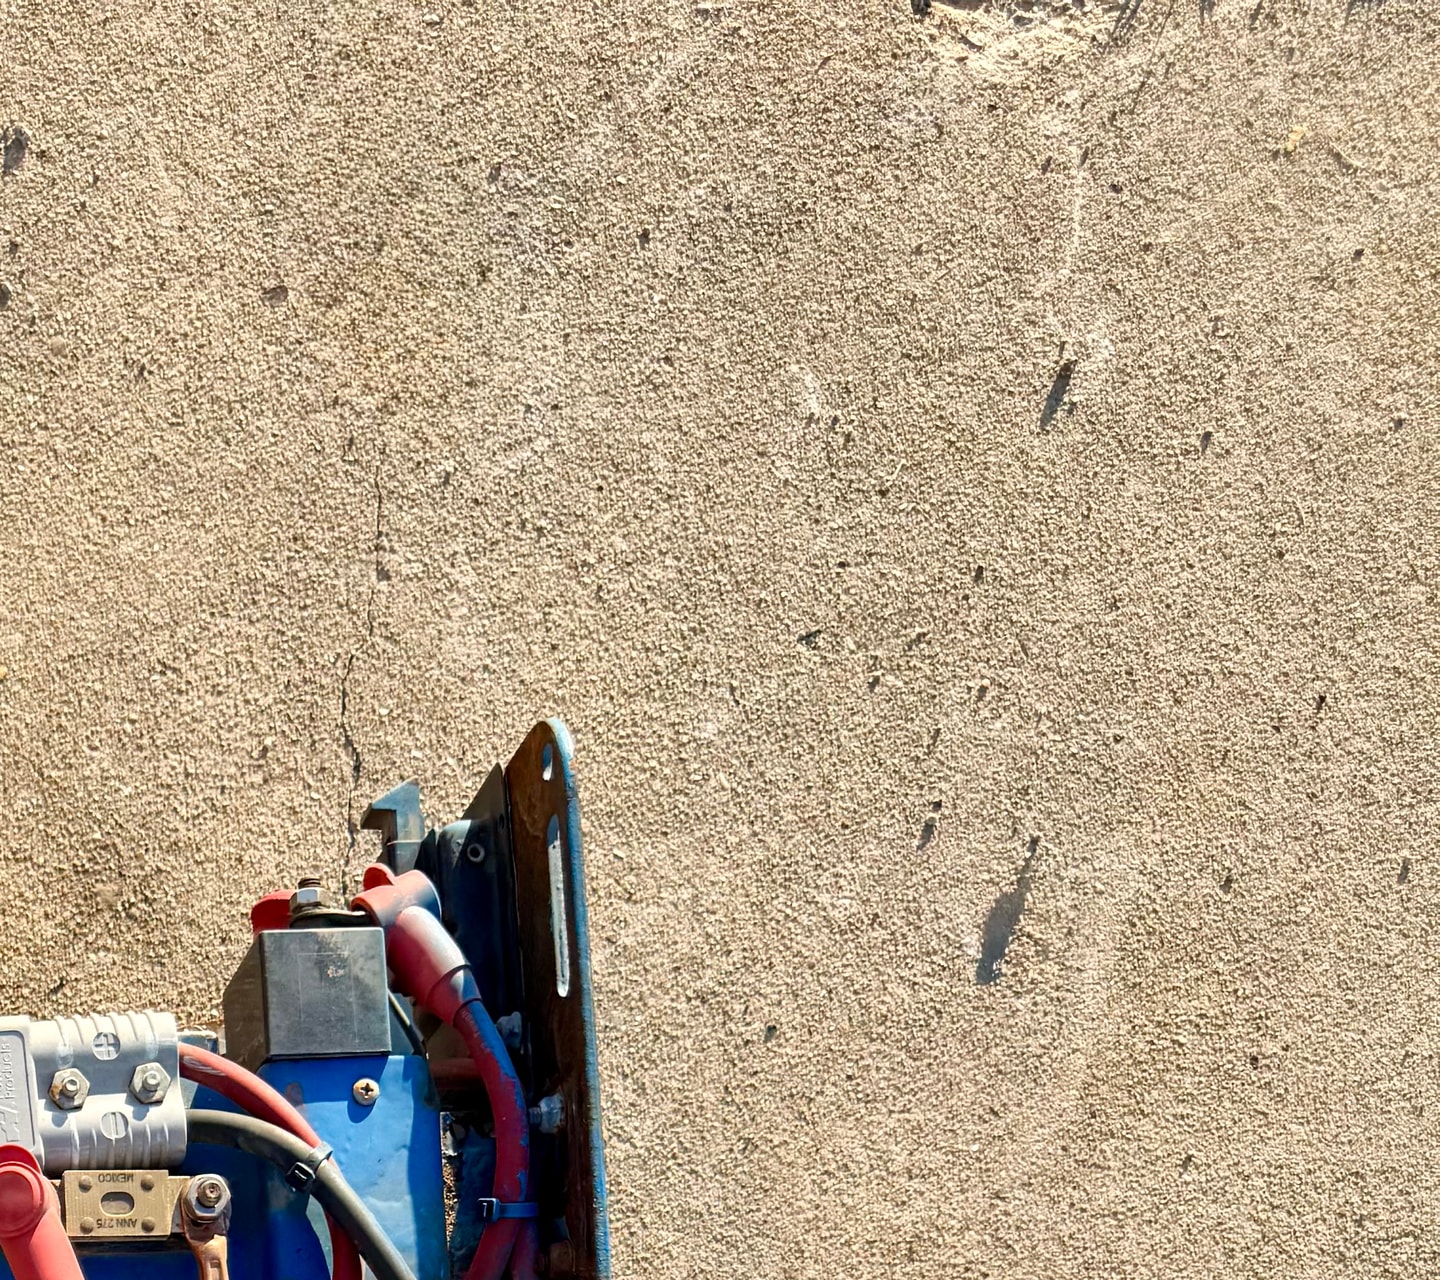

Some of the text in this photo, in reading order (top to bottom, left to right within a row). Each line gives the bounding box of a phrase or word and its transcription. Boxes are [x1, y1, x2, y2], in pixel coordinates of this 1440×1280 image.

[0, 1043, 15, 1099] Products
[98, 1173, 134, 1183] MEXICO
[96, 1218, 137, 1229] ANN 275
